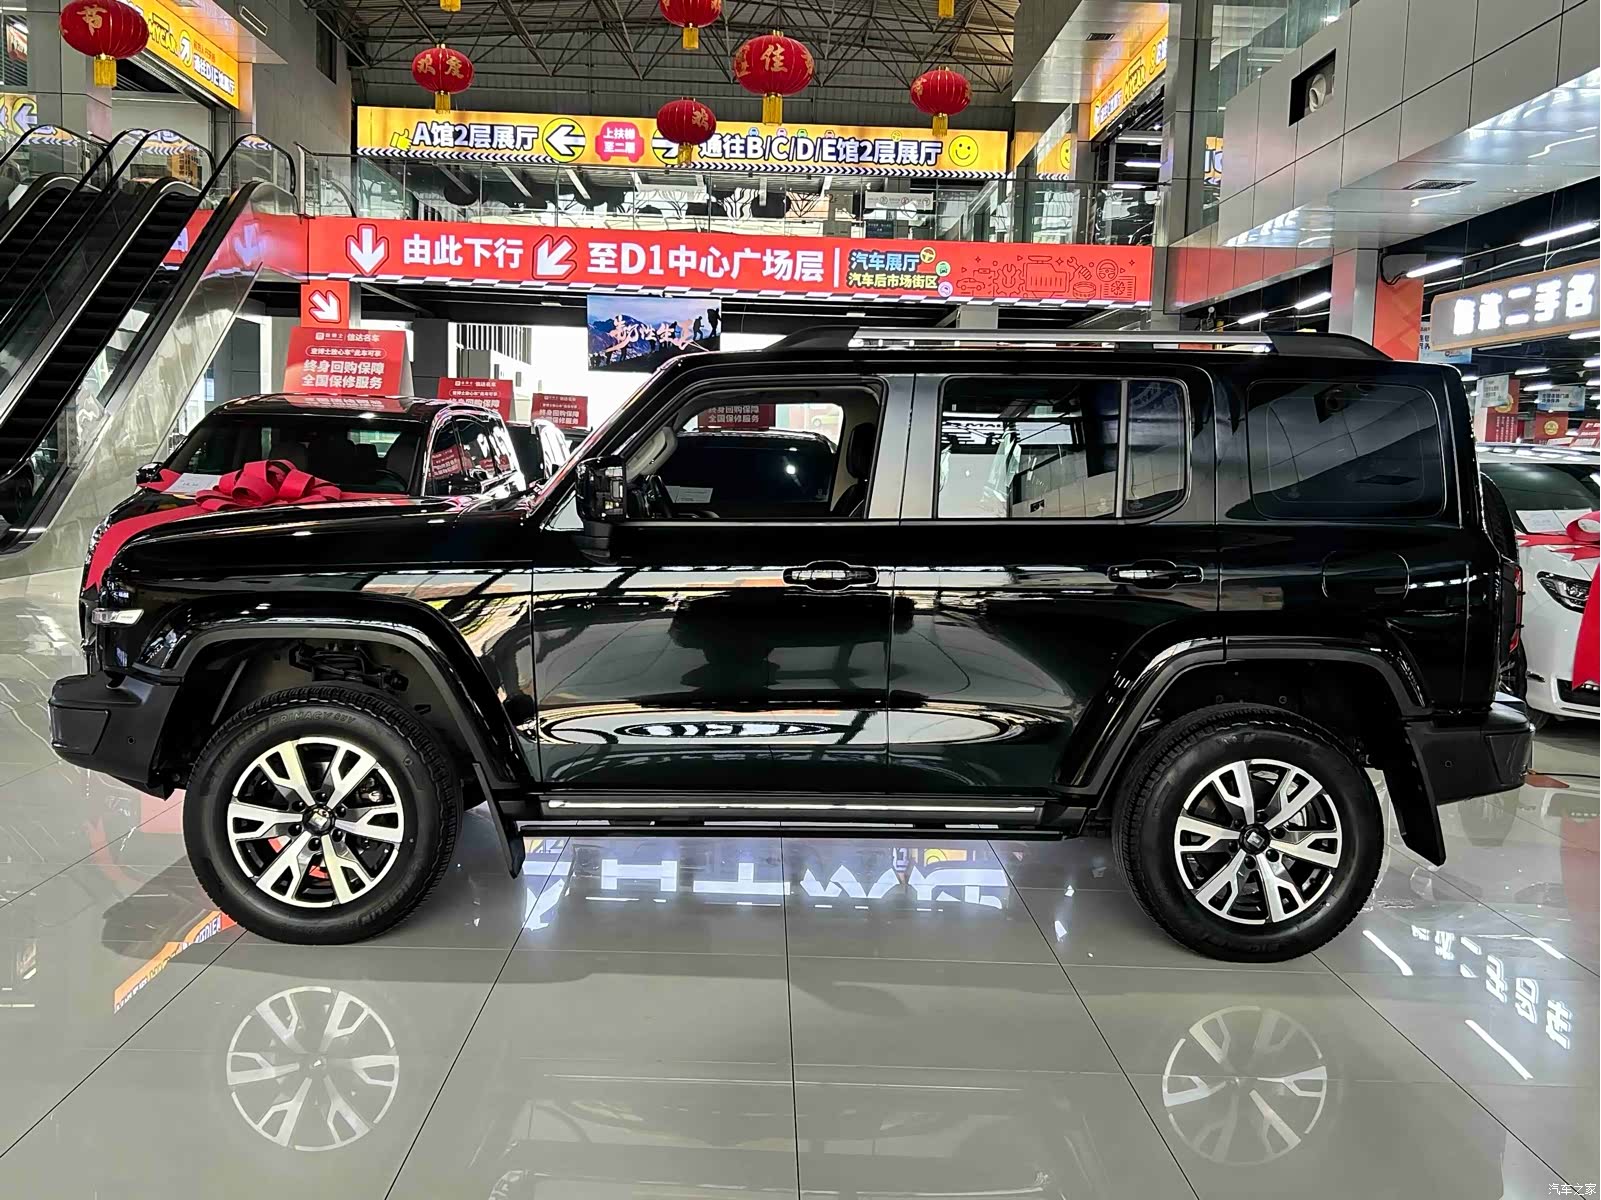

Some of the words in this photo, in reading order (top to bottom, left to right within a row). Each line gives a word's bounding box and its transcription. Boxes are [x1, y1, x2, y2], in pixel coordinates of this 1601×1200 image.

[760, 43, 788, 72] 佳
[412, 121, 539, 151] A馆2层展厅
[700, 133, 942, 166] 通往B/C/D/E馆2层展厅
[403, 233, 524, 270] 由此下行
[587, 242, 824, 283] 至D1中心广场层
[851, 251, 920, 272] 汽车展厅
[848, 272, 938, 289] 汽车后市场街区
[303, 360, 385, 375] 终身回购保障
[302, 374, 383, 389] 全国保修服务
[708, 415, 760, 423] 全国保修服务
[272, 711, 332, 725] PRIMACY
